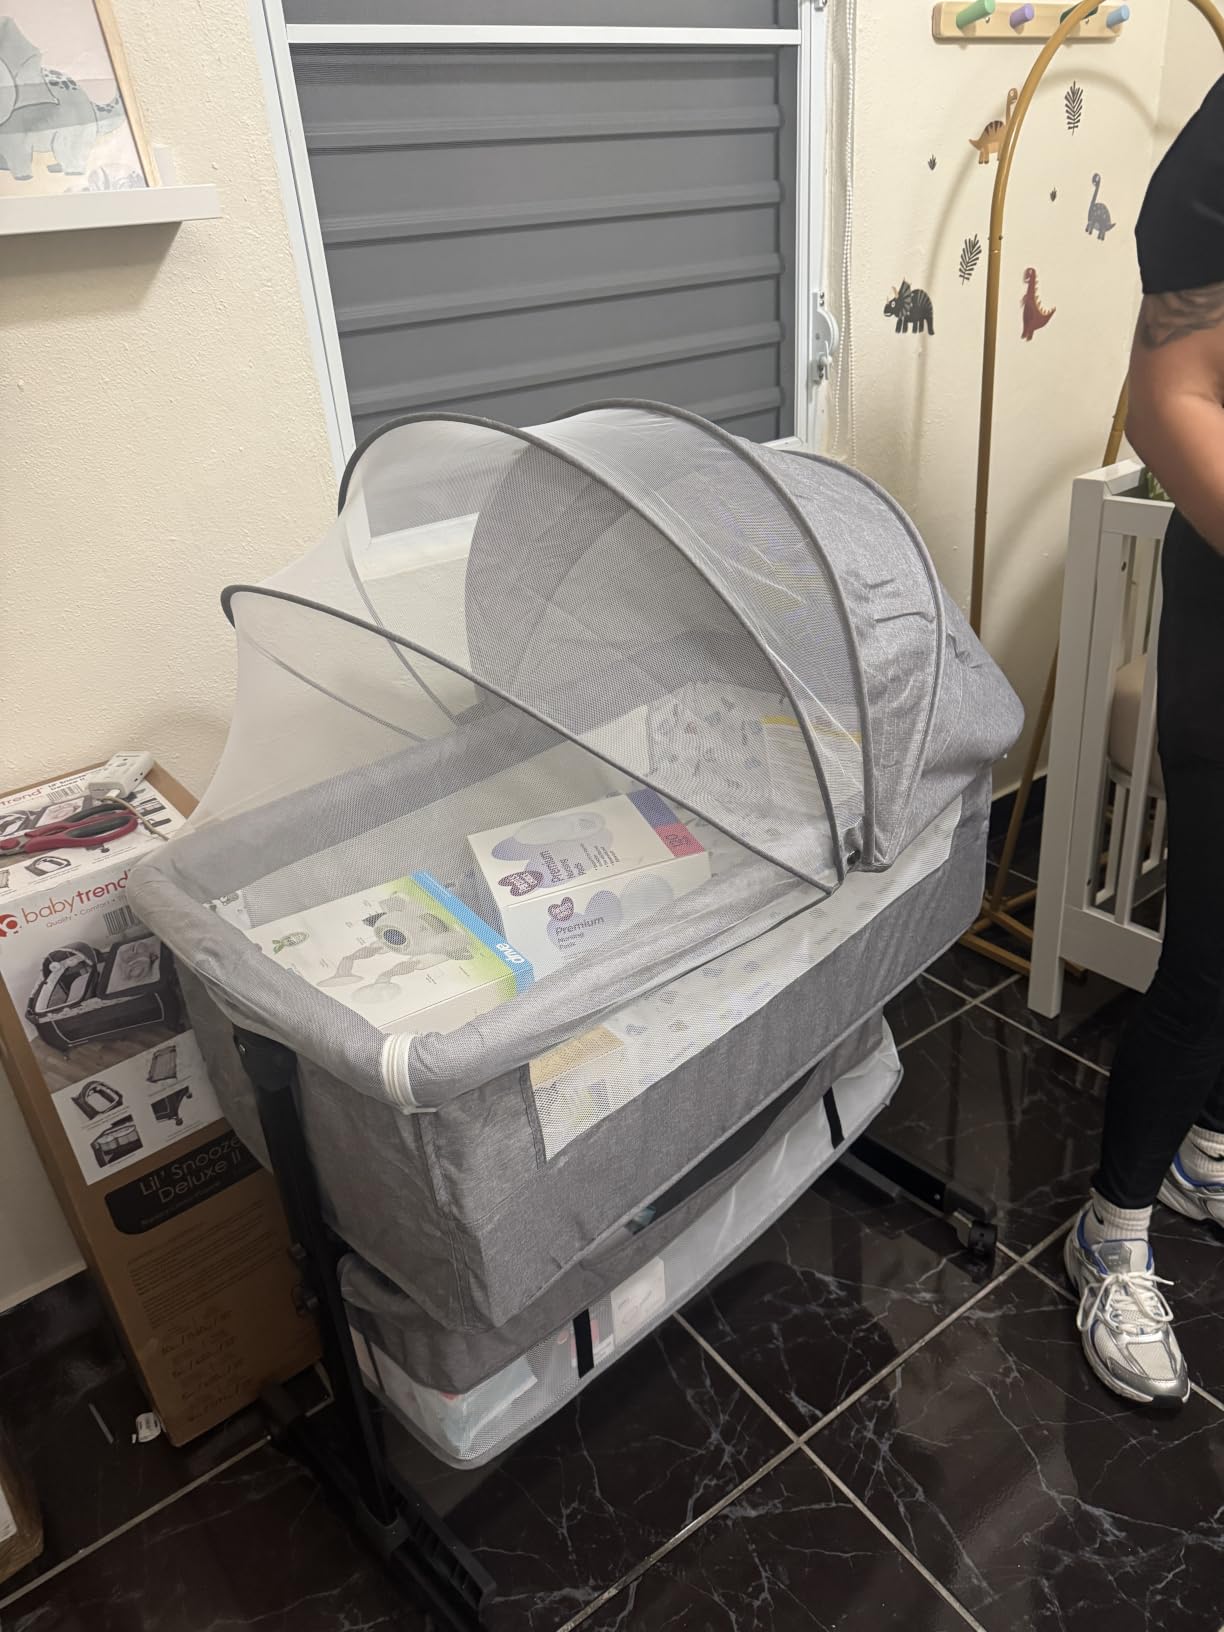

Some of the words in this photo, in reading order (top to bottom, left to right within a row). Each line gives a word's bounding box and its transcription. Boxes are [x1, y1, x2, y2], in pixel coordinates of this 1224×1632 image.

[539, 849, 562, 883] Premium
[559, 857, 576, 879] Nursing
[575, 861, 586, 876] Pads
[555, 916, 605, 936] Premium
[158, 1159, 227, 1204] Deluxe
